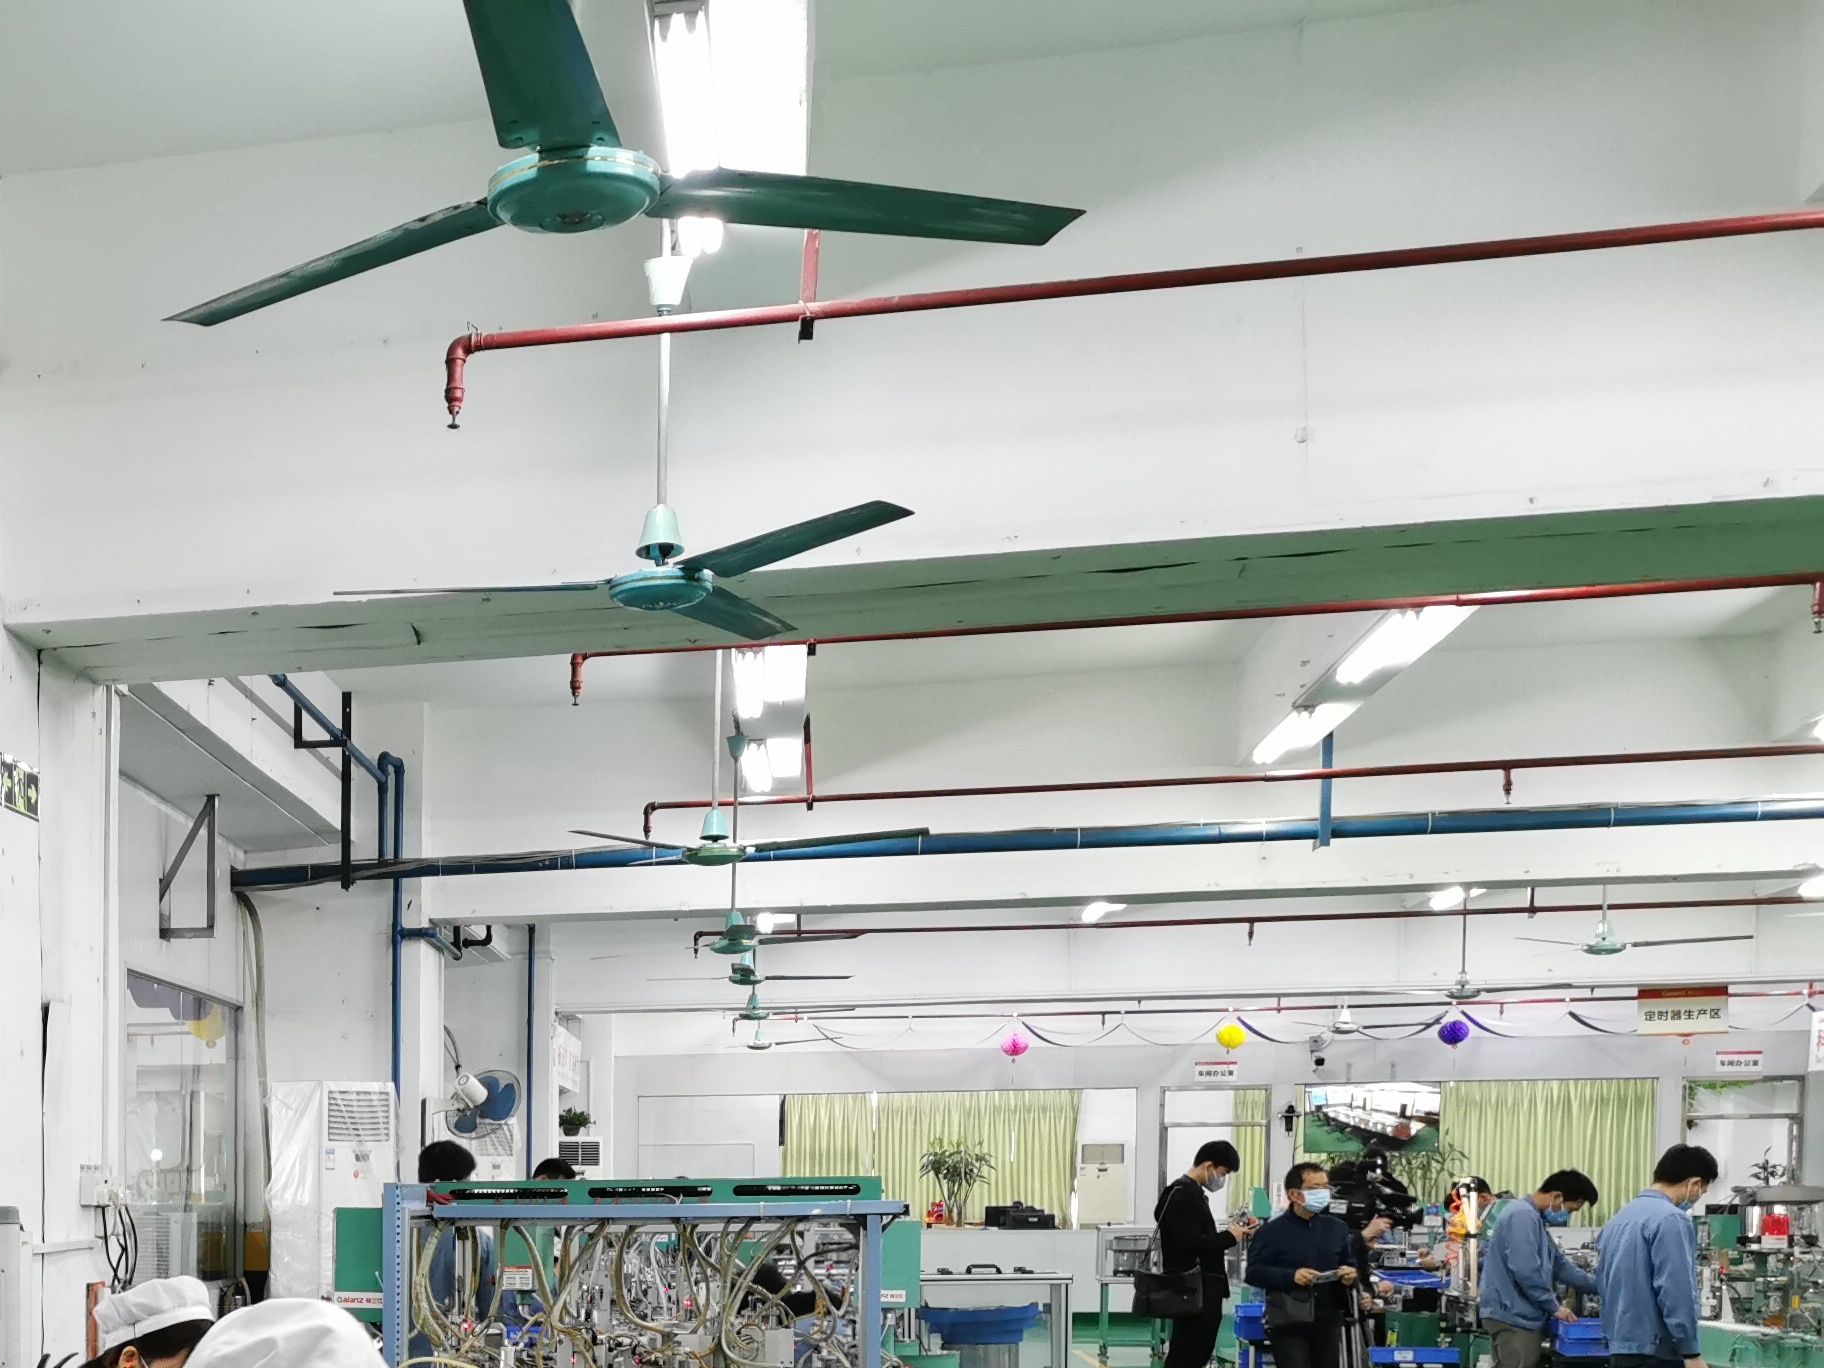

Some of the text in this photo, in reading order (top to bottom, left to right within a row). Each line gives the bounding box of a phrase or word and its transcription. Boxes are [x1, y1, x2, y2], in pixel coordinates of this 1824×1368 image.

[1644, 1008, 1722, 1021] 定时器生产区
[336, 1296, 364, 1305] Galanz
